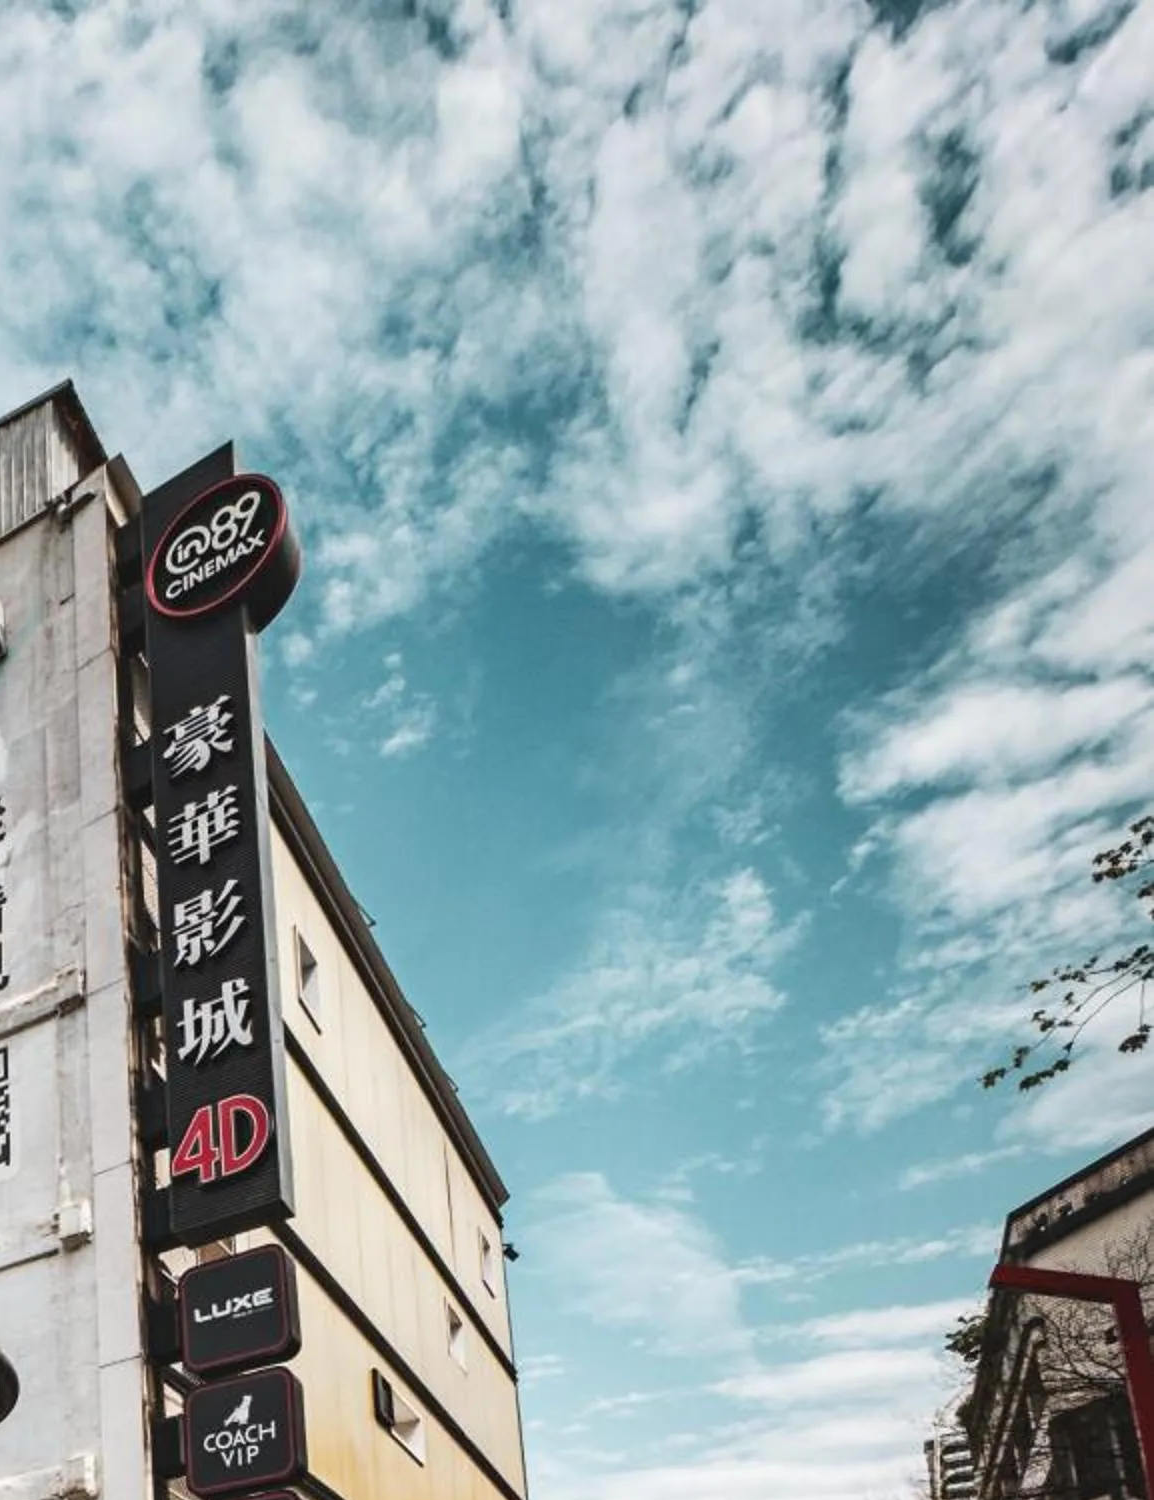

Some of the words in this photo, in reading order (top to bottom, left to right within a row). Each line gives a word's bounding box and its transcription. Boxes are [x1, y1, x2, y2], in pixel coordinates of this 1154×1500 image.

[165, 528, 266, 600] CINEMAX
[163, 694, 254, 1067] 豪華影城
[171, 1093, 271, 1184] 4D
[193, 1287, 275, 1324] LUXE
[203, 1421, 276, 1452] COACH
[221, 1446, 259, 1468] VIP
